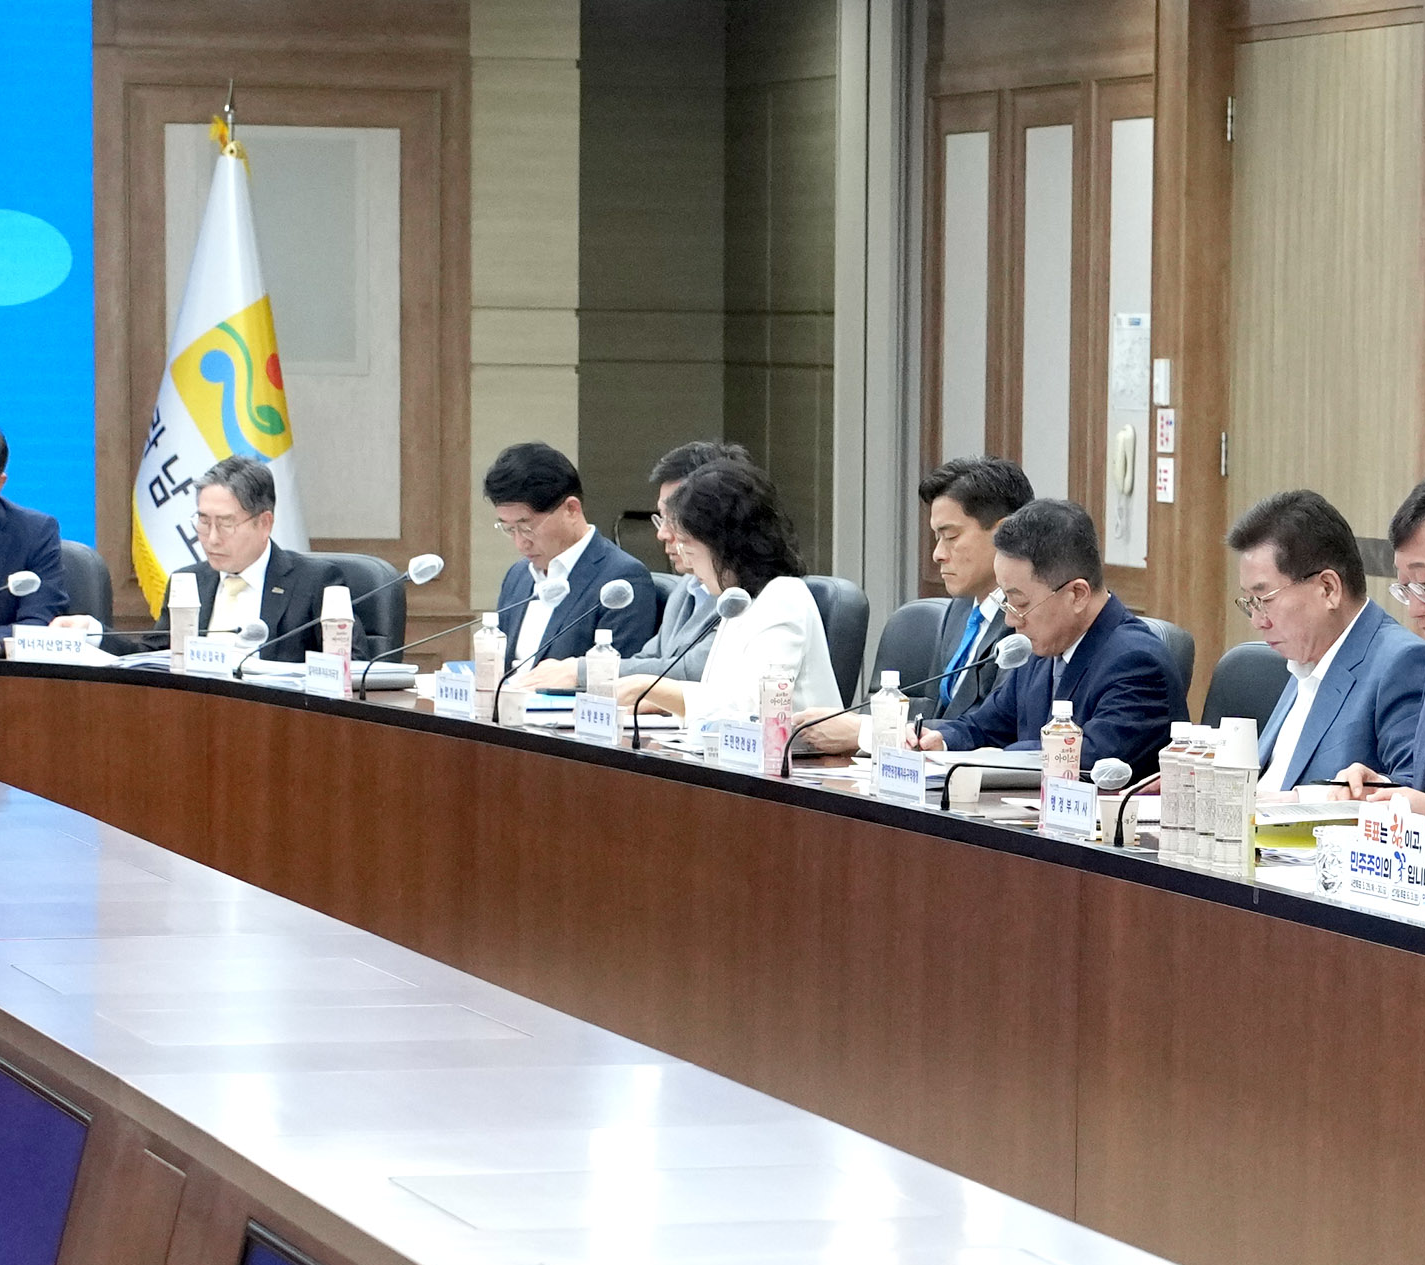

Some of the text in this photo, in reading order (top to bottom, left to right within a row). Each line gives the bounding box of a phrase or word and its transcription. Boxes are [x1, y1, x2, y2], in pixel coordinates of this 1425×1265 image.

[17, 638, 82, 653] 에너지산업국장
[724, 734, 757, 753] 도민안전실장
[1050, 795, 1088, 816] 행정부지사
[1364, 819, 1388, 844] 투표는
[1351, 851, 1392, 880] 민주주의의
